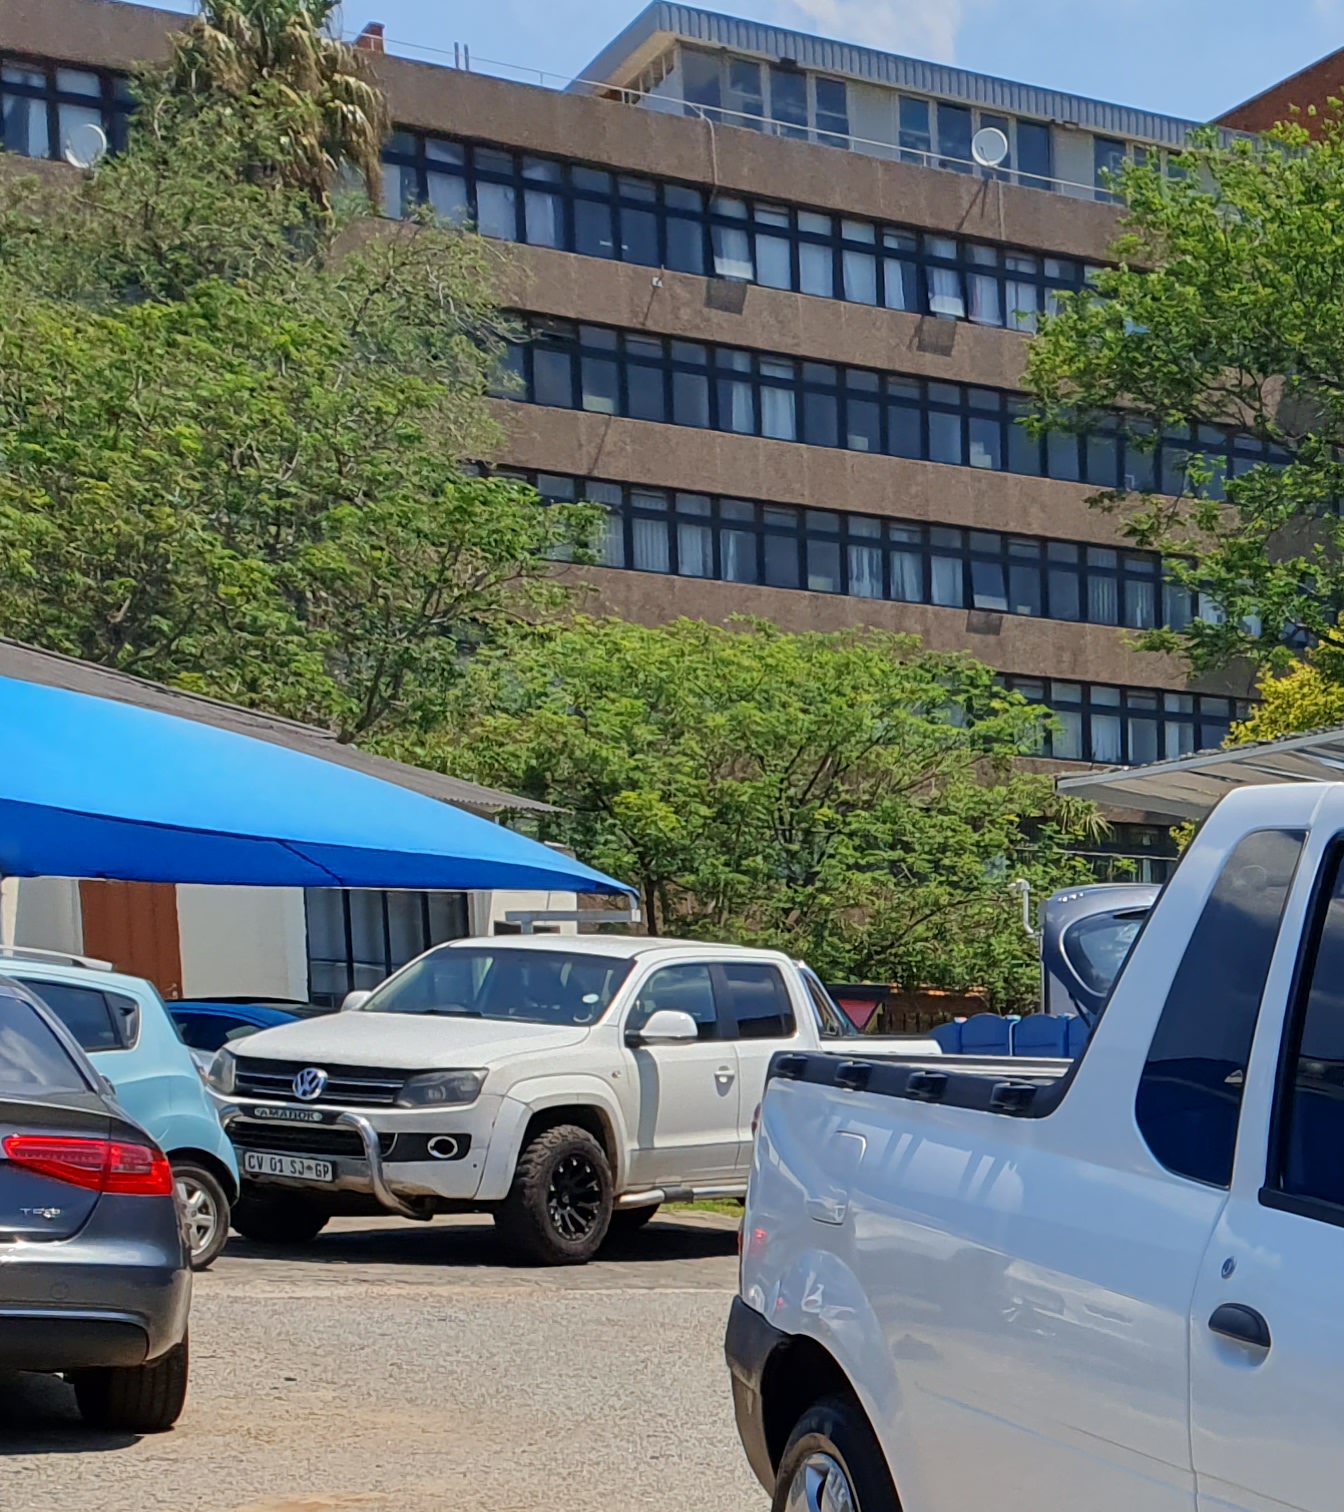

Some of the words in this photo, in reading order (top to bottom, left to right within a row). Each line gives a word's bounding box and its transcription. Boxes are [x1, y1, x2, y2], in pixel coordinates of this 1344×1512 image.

[248, 1154, 264, 1171] CV
[269, 1157, 284, 1173] 01
[290, 1160, 305, 1175] SJ
[315, 1163, 330, 1178] GP
